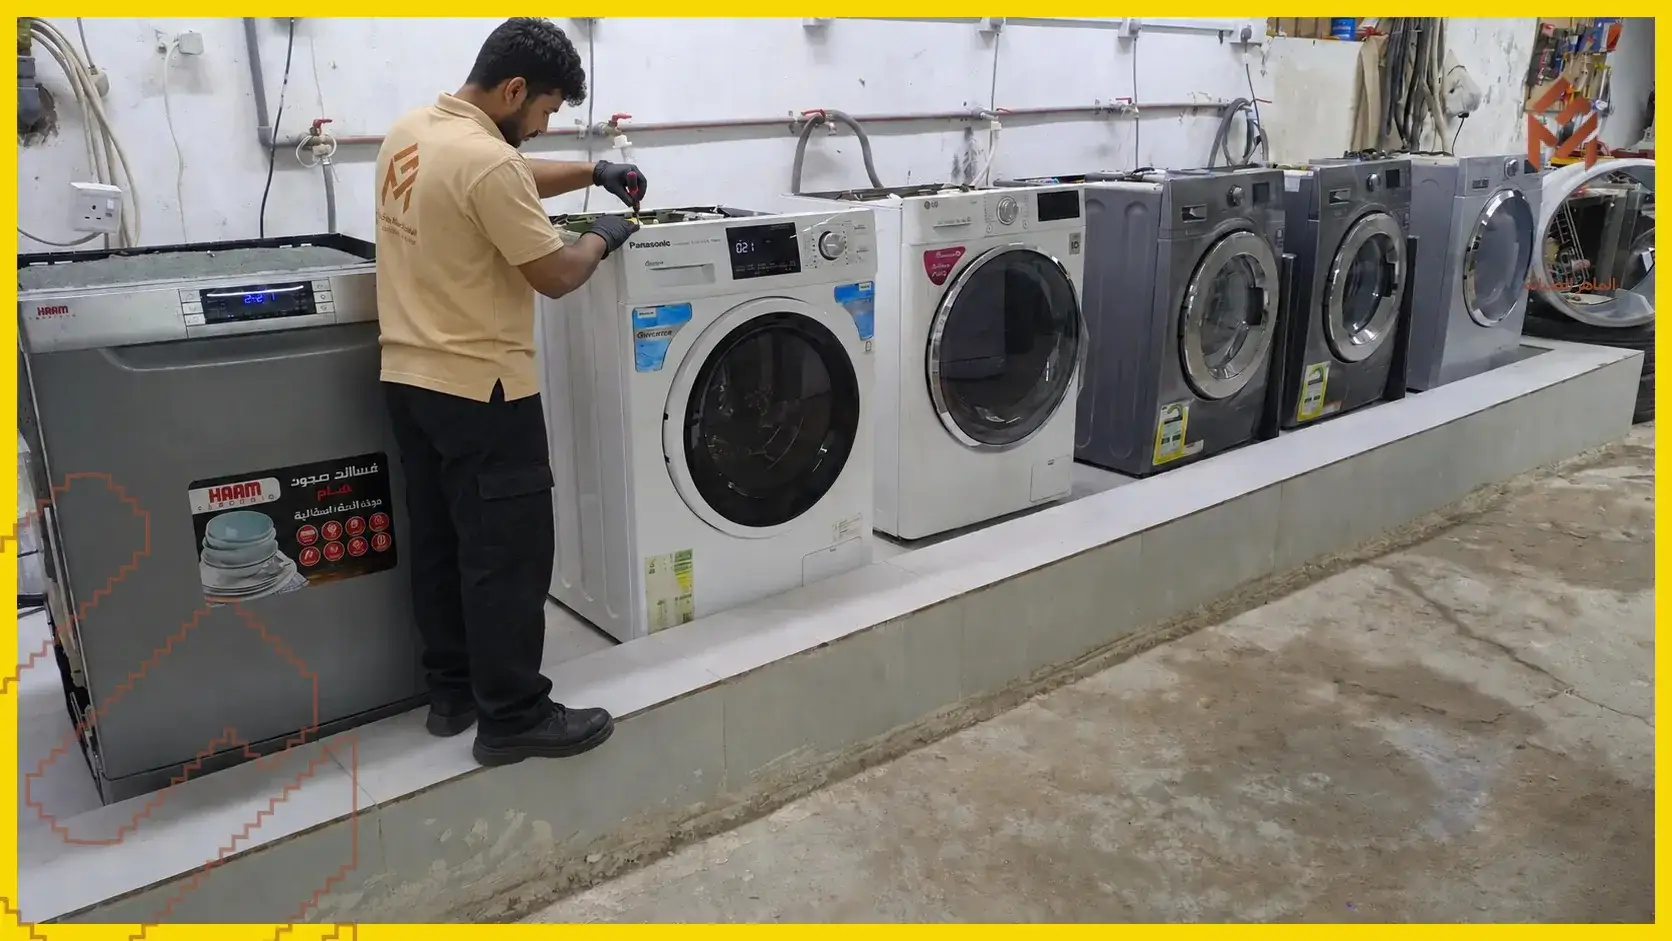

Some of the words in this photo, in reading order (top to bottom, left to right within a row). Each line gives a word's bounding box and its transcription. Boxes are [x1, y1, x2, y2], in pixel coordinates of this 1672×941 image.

[629, 240, 671, 249] Panasonic
[37, 305, 69, 316] HAAM
[208, 481, 262, 503] HAAM
